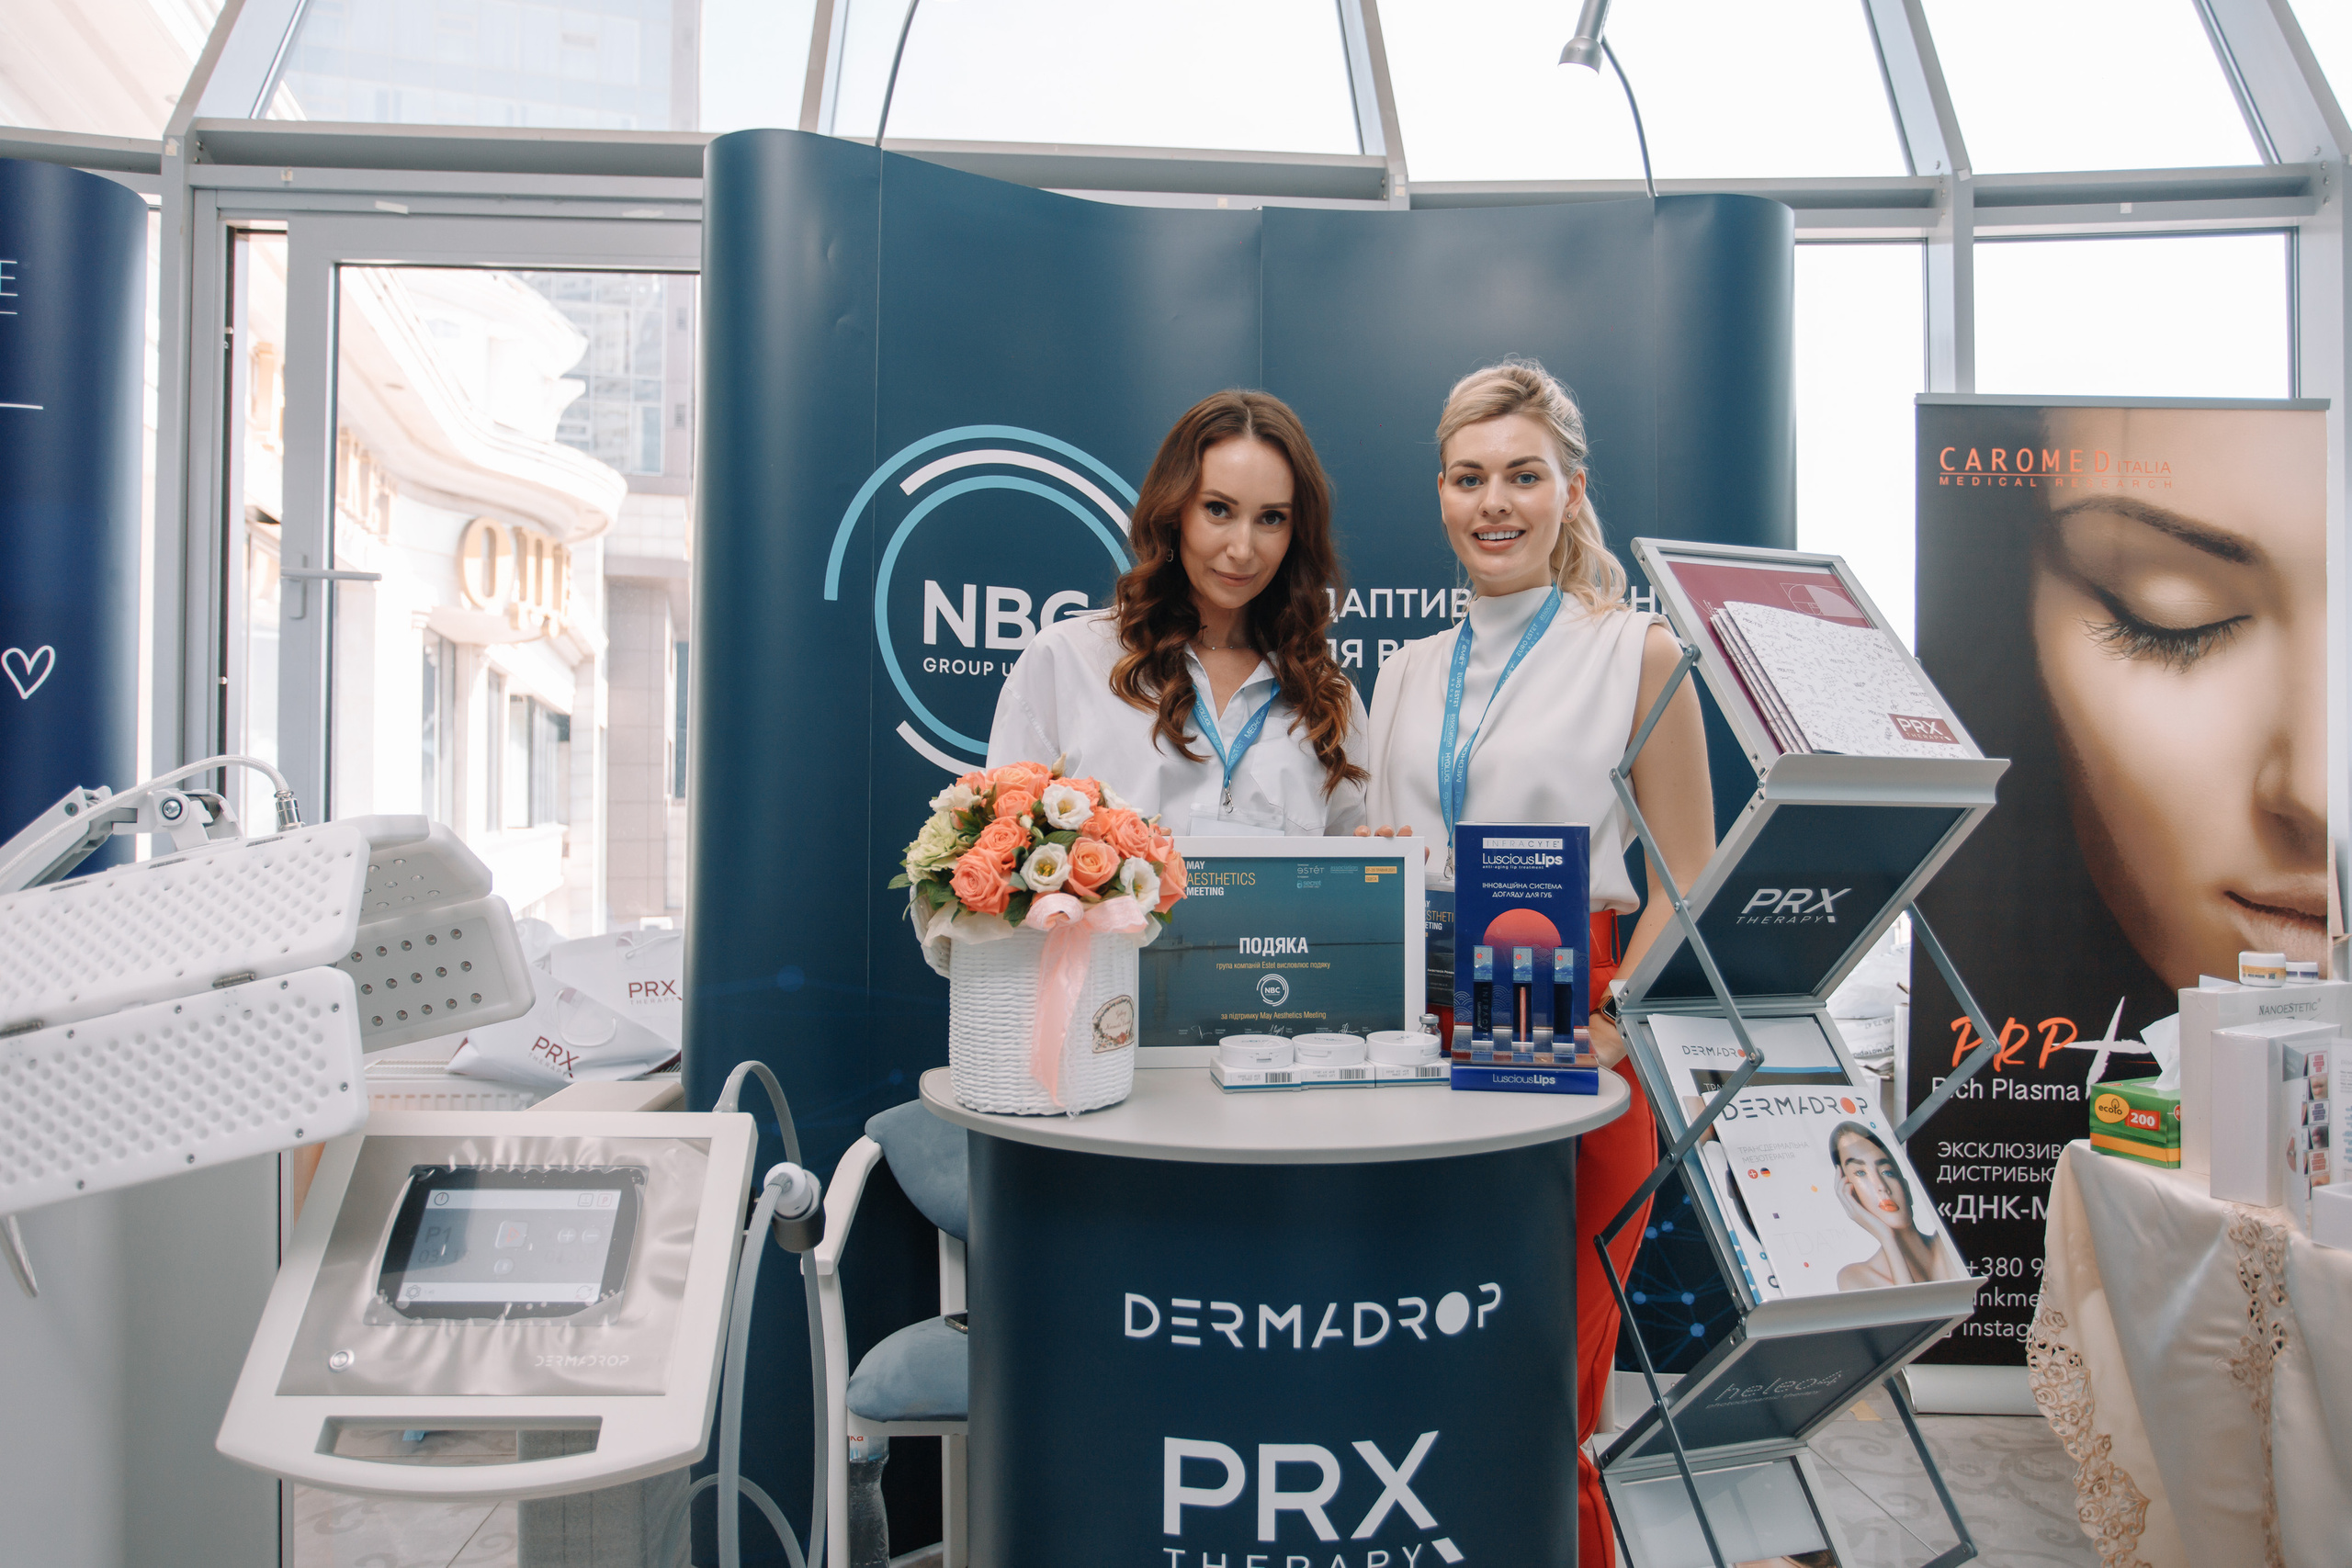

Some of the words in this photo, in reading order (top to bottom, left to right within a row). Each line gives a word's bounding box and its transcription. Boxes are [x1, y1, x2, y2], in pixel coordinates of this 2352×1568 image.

[1939, 446, 2110, 472] CAROMED
[2118, 460, 2171, 474] ITALIA
[1939, 476, 2037, 487] MEDICAL
[2055, 478, 2172, 489] RESEARCH
[1516, 638, 1528, 657] EURO
[1525, 623, 1538, 640] ESTET
[923, 657, 994, 676] GROUP
[1455, 671, 1464, 689] EURO
[1453, 690, 1462, 707] ESTET
[1244, 709, 1265, 739] MEDHOME
[1447, 713, 1456, 748] association
[1896, 717, 1944, 736] PRX
[1905, 732, 1943, 740] THERAPY
[1186, 861, 1205, 870] MAY
[1187, 873, 1256, 886] AESTHETICS
[1186, 887, 1225, 897] MEETING
[1741, 888, 1852, 913] PRX
[1736, 916, 1824, 924] THERAPY
[1239, 937, 1309, 956] ПОДЯКА
[1234, 961, 1261, 969] компаній
[1261, 961, 1276, 969] Estet
[1310, 962, 1330, 970] подяку
[628, 980, 677, 998] PRX
[1229, 1012, 1259, 1021] підтримку
[1260, 1011, 1272, 1021] May
[1273, 1011, 1303, 1020] Aesthetics
[1304, 1010, 1327, 1020] Meeting
[531, 1035, 580, 1071] PRX
[1493, 1074, 1556, 1086] LusciousLips
[1992, 1078, 2080, 1100] Plasma
[1722, 1097, 1868, 1121] DERMADROP
[2131, 1112, 2155, 1127] 200
[1737, 1141, 1810, 1155] ТРАНСДЕРМАЛЬНА
[1742, 1153, 1796, 1165] МЕЗОТЕРАПІЯ
[1966, 1257, 2023, 1278] +380
[1125, 1282, 1501, 1348] DERMADROP
[535, 1355, 629, 1367] DERMADROP
[1163, 1430, 1440, 1542] PRX
